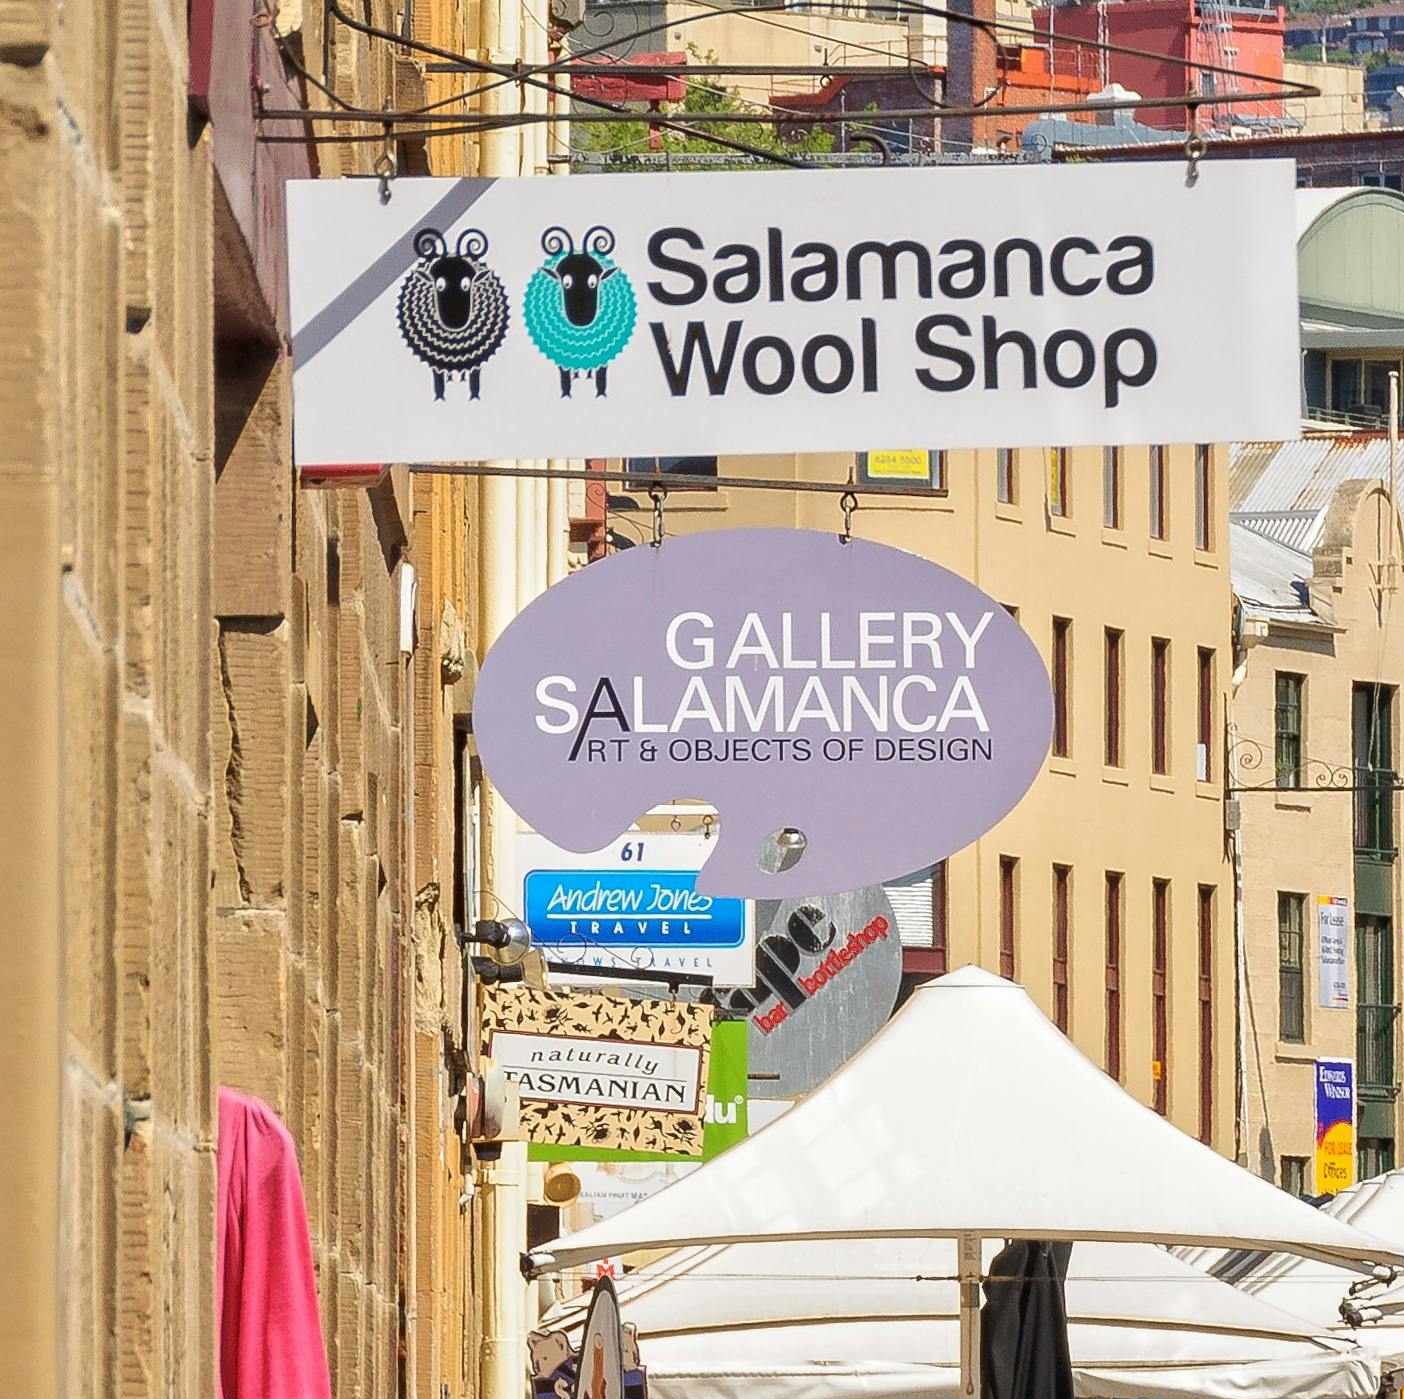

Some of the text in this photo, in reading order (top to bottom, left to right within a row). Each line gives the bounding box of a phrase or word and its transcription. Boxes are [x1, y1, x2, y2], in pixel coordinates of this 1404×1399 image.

[646, 226, 1155, 306] Salamanca
[649, 313, 1158, 409] Wool Shop
[666, 611, 995, 670] GALLERY
[535, 674, 990, 736] SALAMANCA
[639, 738, 660, 762] &
[668, 737, 812, 764] OBJECTS
[822, 737, 865, 763] OF
[874, 737, 994, 762] DESIGN
[620, 841, 645, 863] 61
[545, 880, 644, 912] Andrew
[570, 921, 692, 935] TRAVEL
[634, 956, 713, 968] TRAVEL
[753, 1001, 789, 1034] bar
[530, 1047, 661, 1075] naturally
[504, 1070, 687, 1104] TASMANIAN
